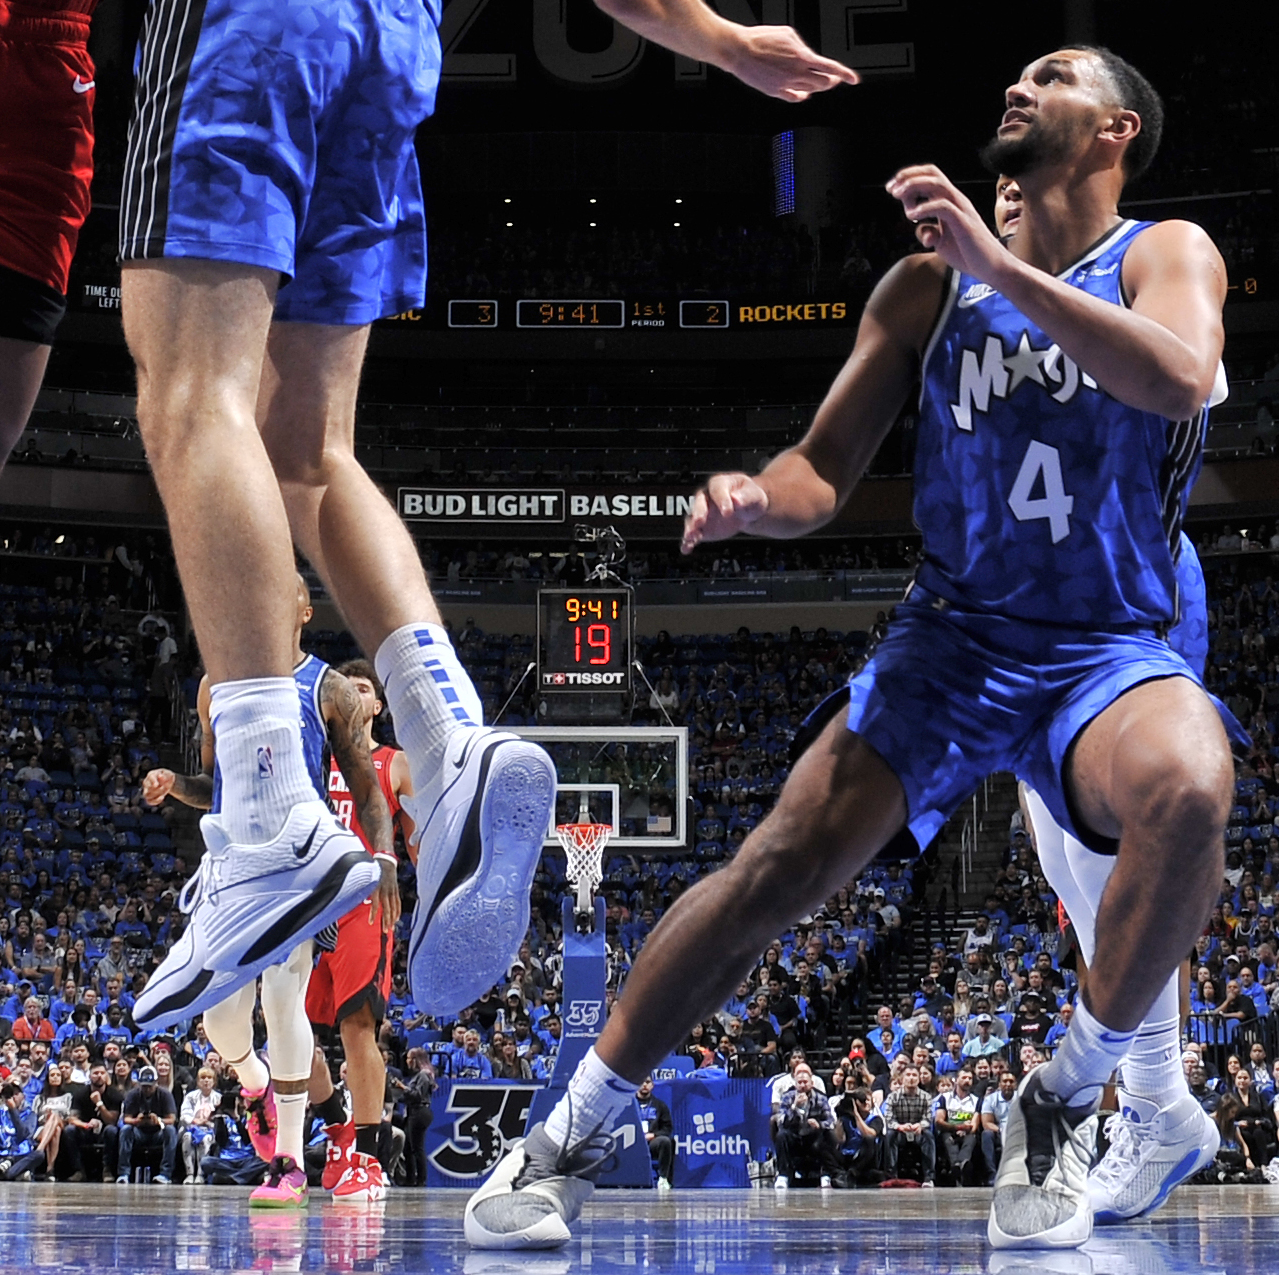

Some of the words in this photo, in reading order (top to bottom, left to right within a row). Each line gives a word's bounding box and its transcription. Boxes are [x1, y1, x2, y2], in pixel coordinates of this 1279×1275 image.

[84, 284, 107, 297] TIME
[99, 297, 120, 309] LEFT
[632, 302, 666, 317] 1st
[739, 302, 847, 323] ROCKETS
[477, 306, 491, 323] 3
[539, 303, 600, 325] 9:41
[631, 319, 665, 328] PERIOD
[706, 306, 720, 324] 2
[1007, 439, 1074, 545] 4
[403, 494, 467, 516] BUD
[471, 494, 559, 516] LIGHT
[571, 494, 695, 517] BASELIN
[565, 597, 619, 623] 9:41
[574, 623, 611, 665] 19
[565, 672, 625, 685] TISSOT
[565, 999, 602, 1026] 35
[674, 1133, 750, 1156] Health
